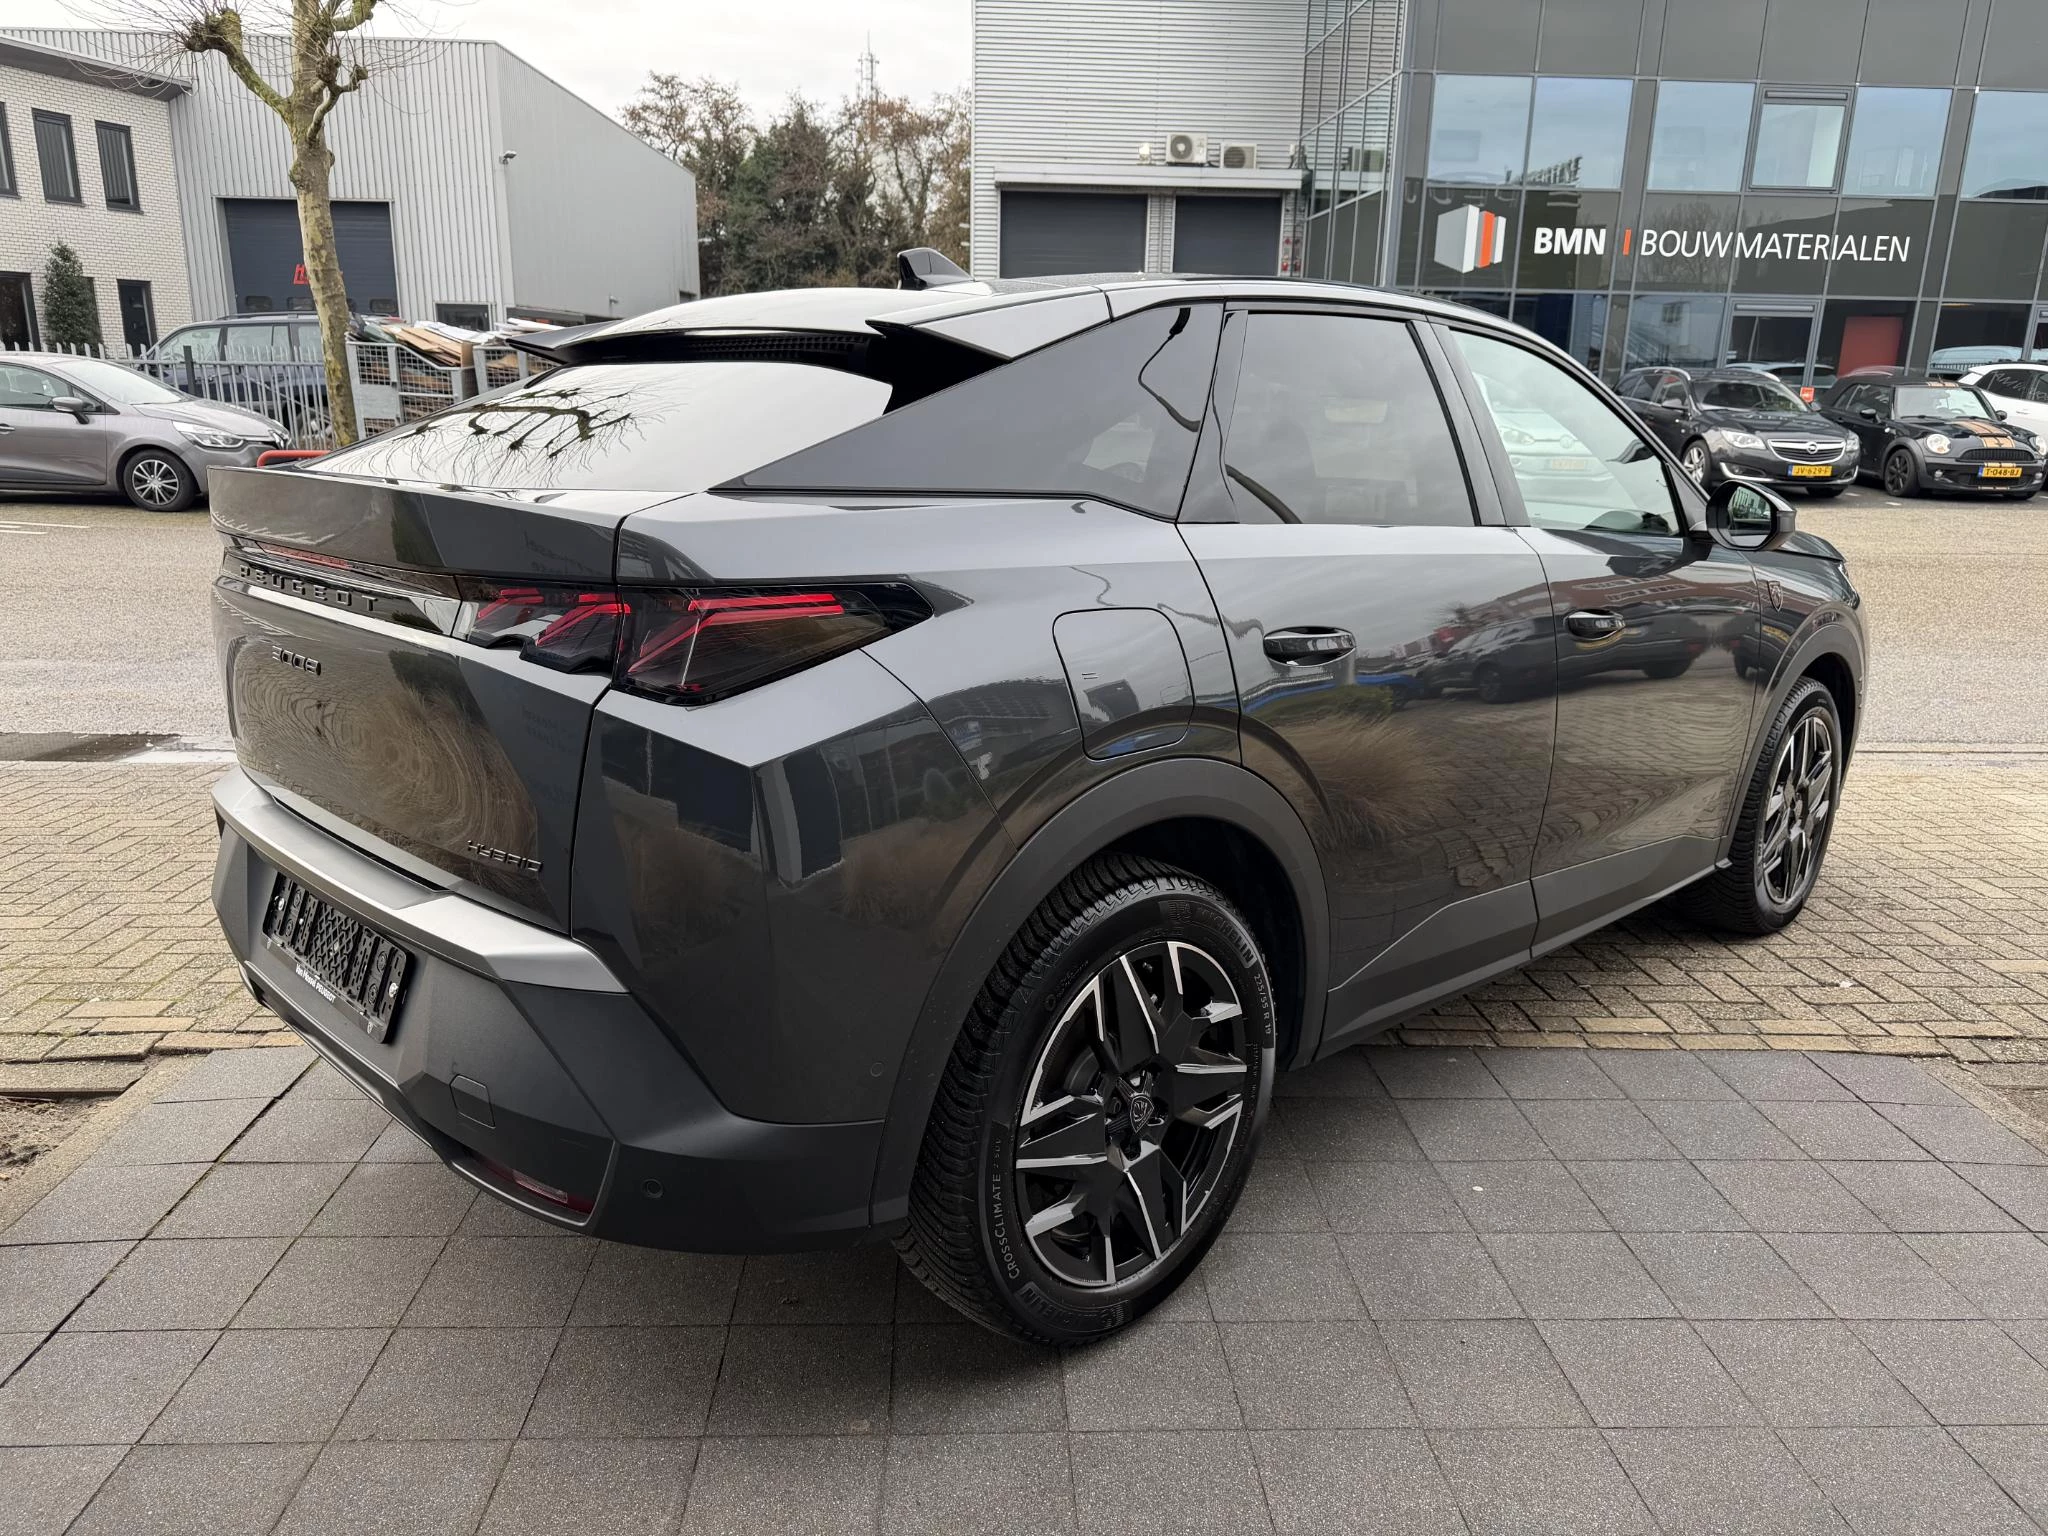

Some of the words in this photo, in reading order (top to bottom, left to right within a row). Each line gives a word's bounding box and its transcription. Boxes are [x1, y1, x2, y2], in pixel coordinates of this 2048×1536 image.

[1533, 227, 1606, 255] BMN
[1640, 229, 1911, 263] BOUWMATERIALEN
[239, 564, 379, 612] PEUGEOT
[271, 645, 322, 676] 3008
[467, 840, 543, 873] HYBRID
[315, 981, 336, 1004] PEUGEOT
